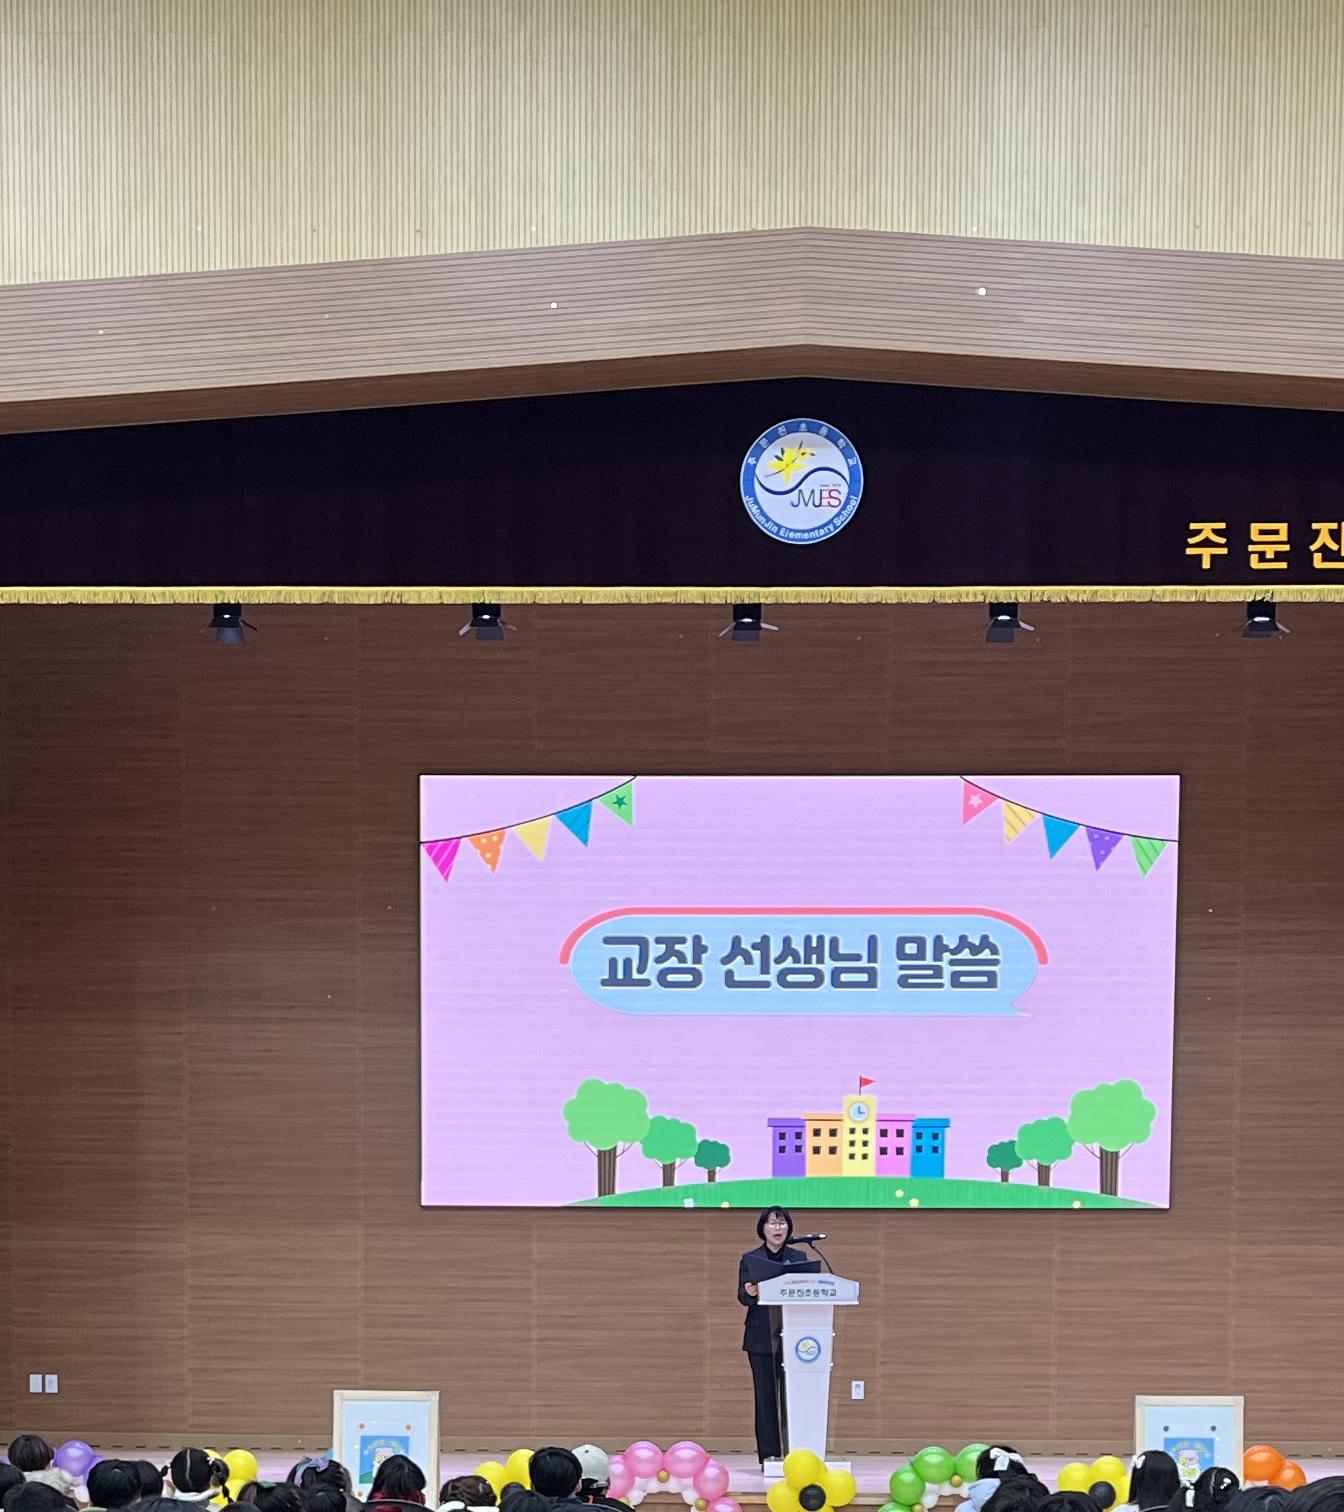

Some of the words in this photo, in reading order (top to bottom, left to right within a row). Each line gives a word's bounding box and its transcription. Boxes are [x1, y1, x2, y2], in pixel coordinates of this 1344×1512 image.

[834, 495, 859, 527] School
[600, 934, 709, 989] 교장
[720, 934, 879, 990] 선생님
[896, 934, 1001, 990] 말씀
[780, 1288, 837, 1298] 주문진초등학교
